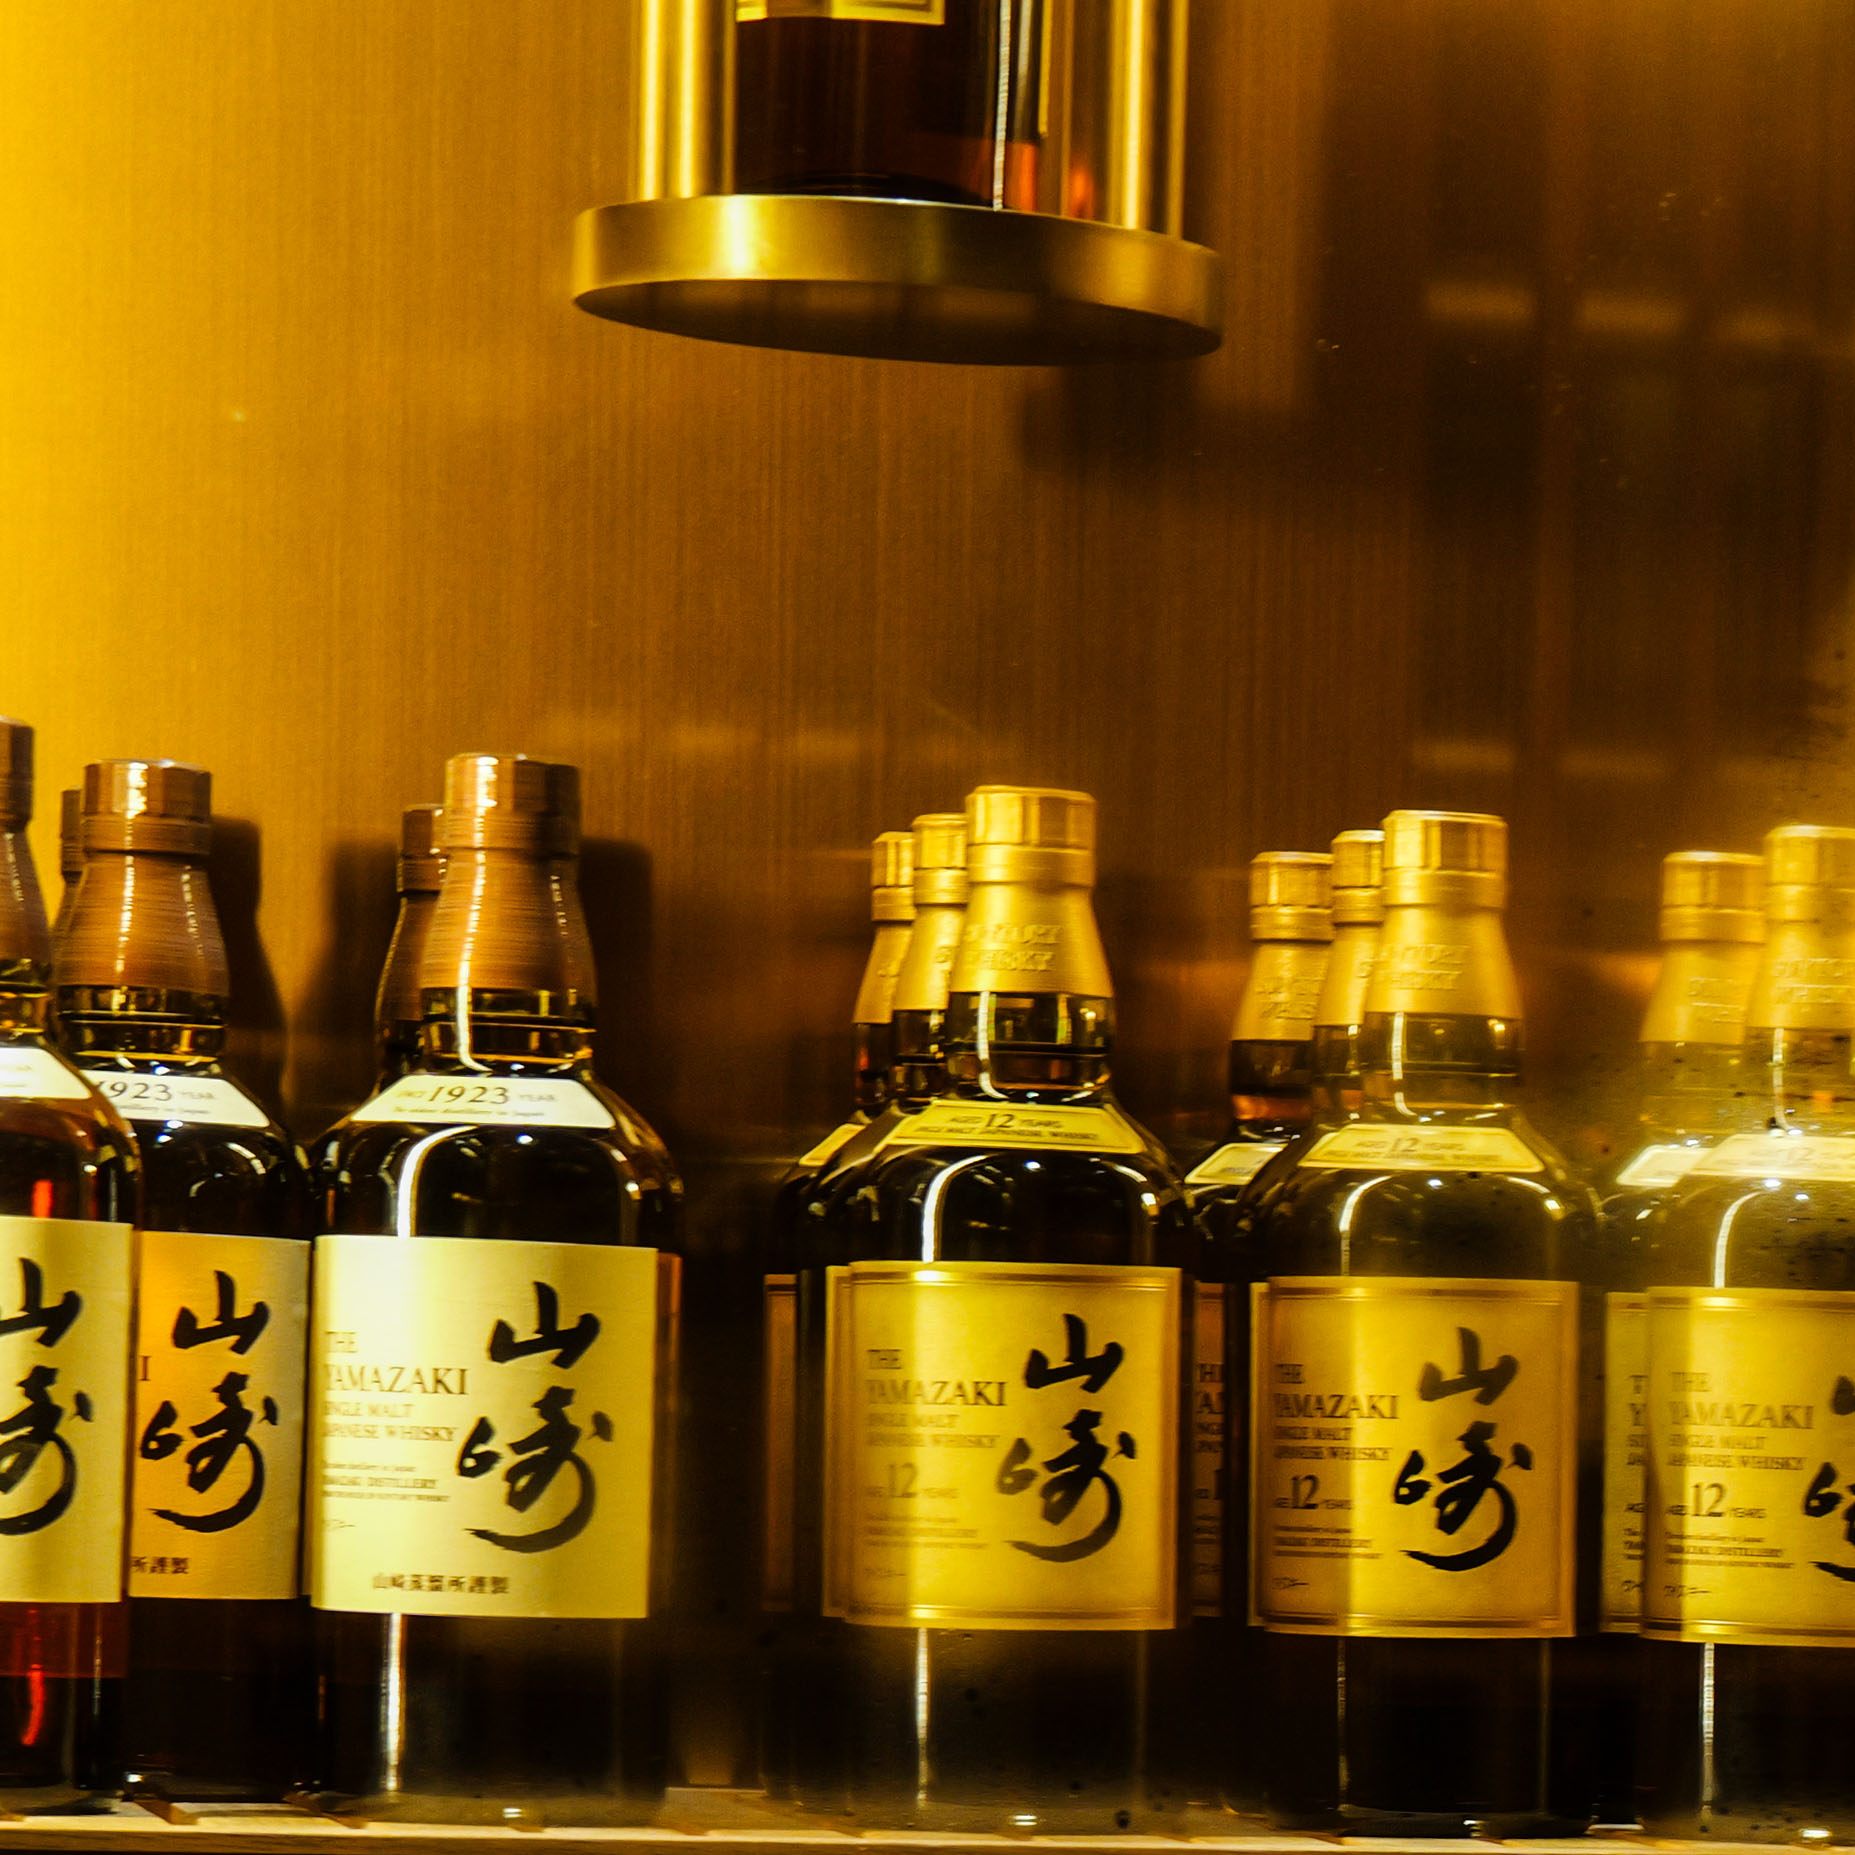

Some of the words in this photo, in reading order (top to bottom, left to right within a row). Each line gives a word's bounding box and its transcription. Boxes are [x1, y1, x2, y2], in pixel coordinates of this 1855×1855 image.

[97, 1080, 173, 1102] 923
[428, 1086, 510, 1105] 1923
[985, 1113, 1016, 1129] 12
[324, 1364, 469, 1395] YAMAZAKI
[866, 1379, 1009, 1407] YAMAZAKI
[140, 1269, 278, 1533] 山崎
[457, 1281, 613, 1553] 山崎
[1274, 1393, 1400, 1419] YAMAZAKI
[1668, 1402, 1815, 1429] YAMAZAKI
[997, 1313, 1137, 1562] 山崎
[1394, 1326, 1533, 1571] 山崎
[887, 1462, 919, 1499] 12
[1290, 1474, 1321, 1510] 12
[1691, 1482, 1727, 1517] 12
